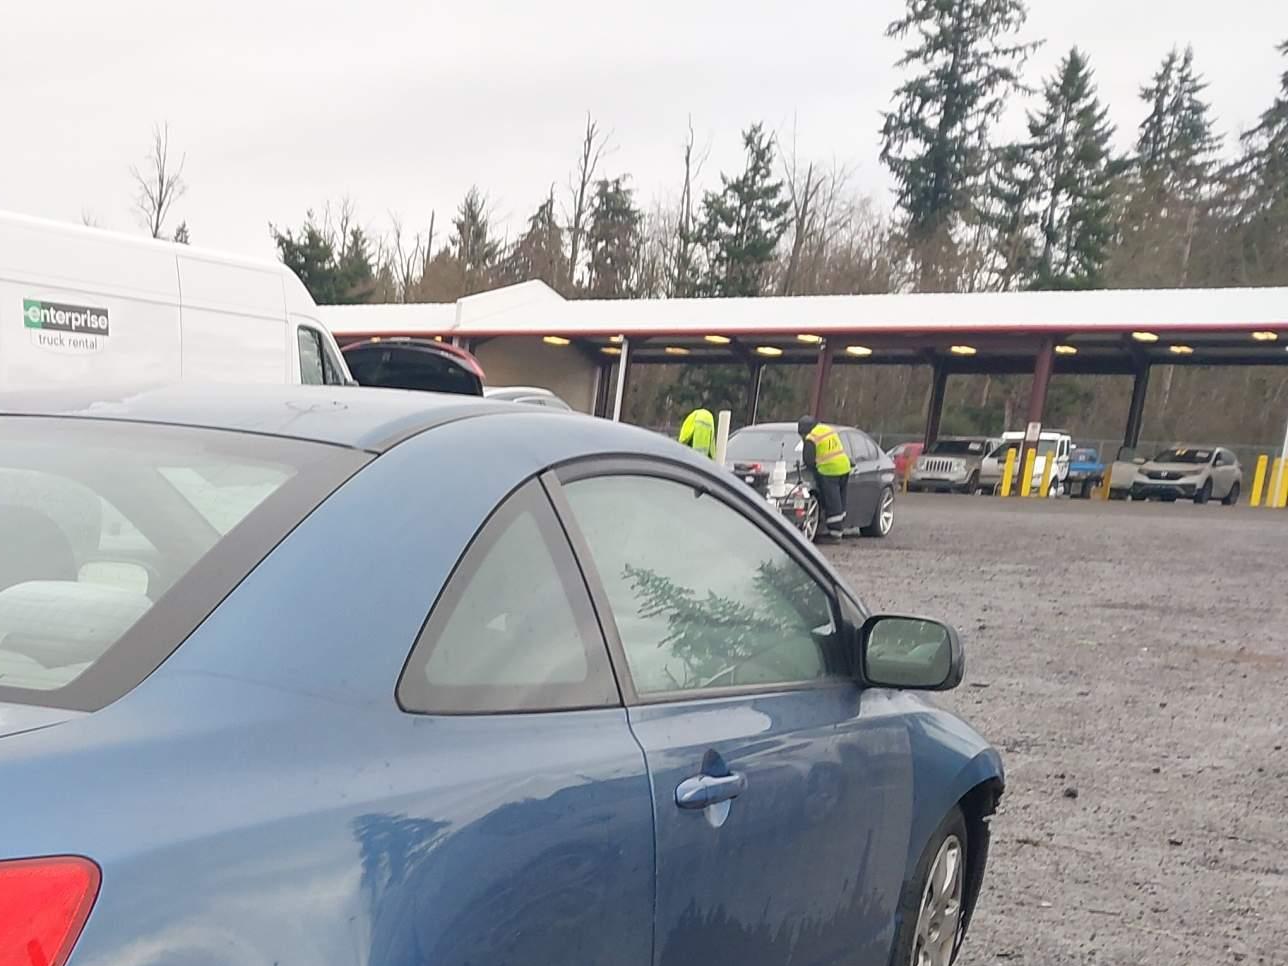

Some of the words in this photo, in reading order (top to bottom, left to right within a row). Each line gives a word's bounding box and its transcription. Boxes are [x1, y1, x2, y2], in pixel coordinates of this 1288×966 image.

[24, 305, 108, 330] enterprise
[38, 332, 65, 347] truck
[68, 337, 98, 351] rental
